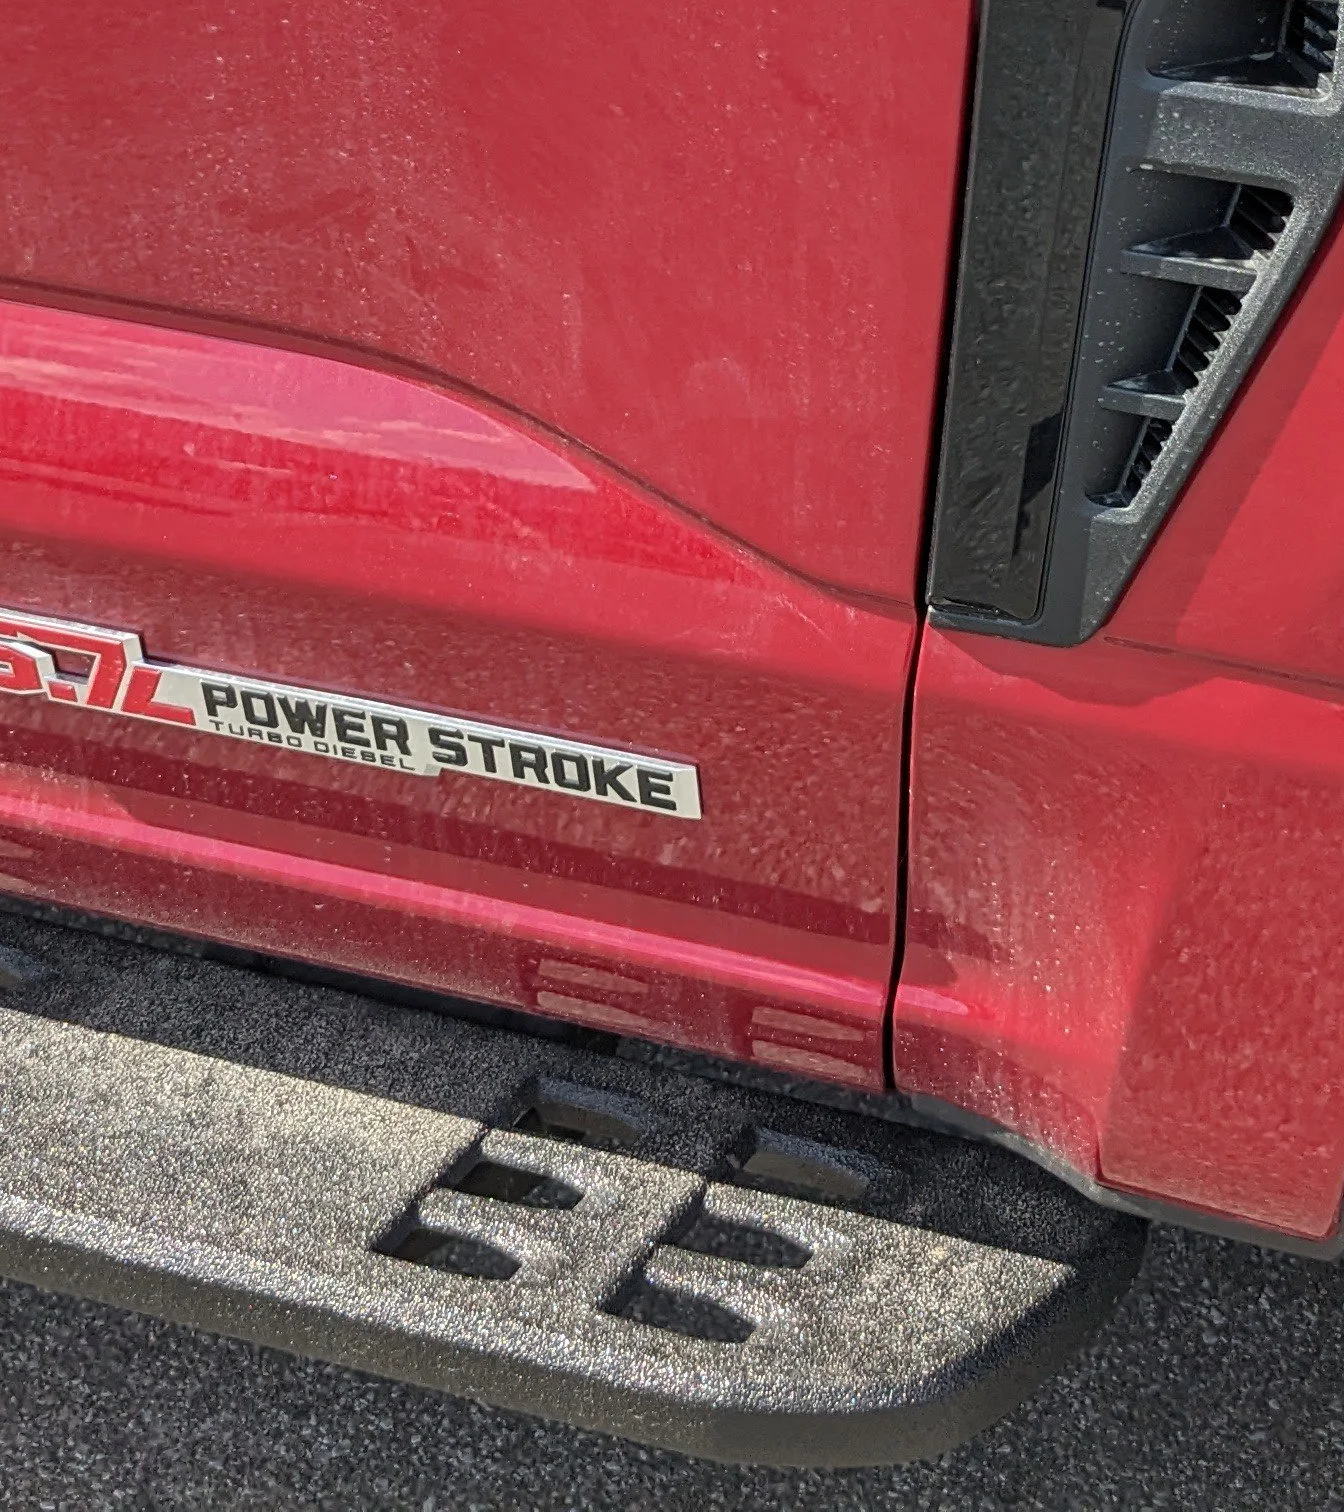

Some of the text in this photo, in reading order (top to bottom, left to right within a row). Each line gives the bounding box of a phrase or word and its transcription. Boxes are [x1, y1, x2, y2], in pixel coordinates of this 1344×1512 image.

[201, 680, 413, 757] POWER
[427, 727, 678, 812] STROKE
[208, 718, 417, 772] TURBO DIESEL
